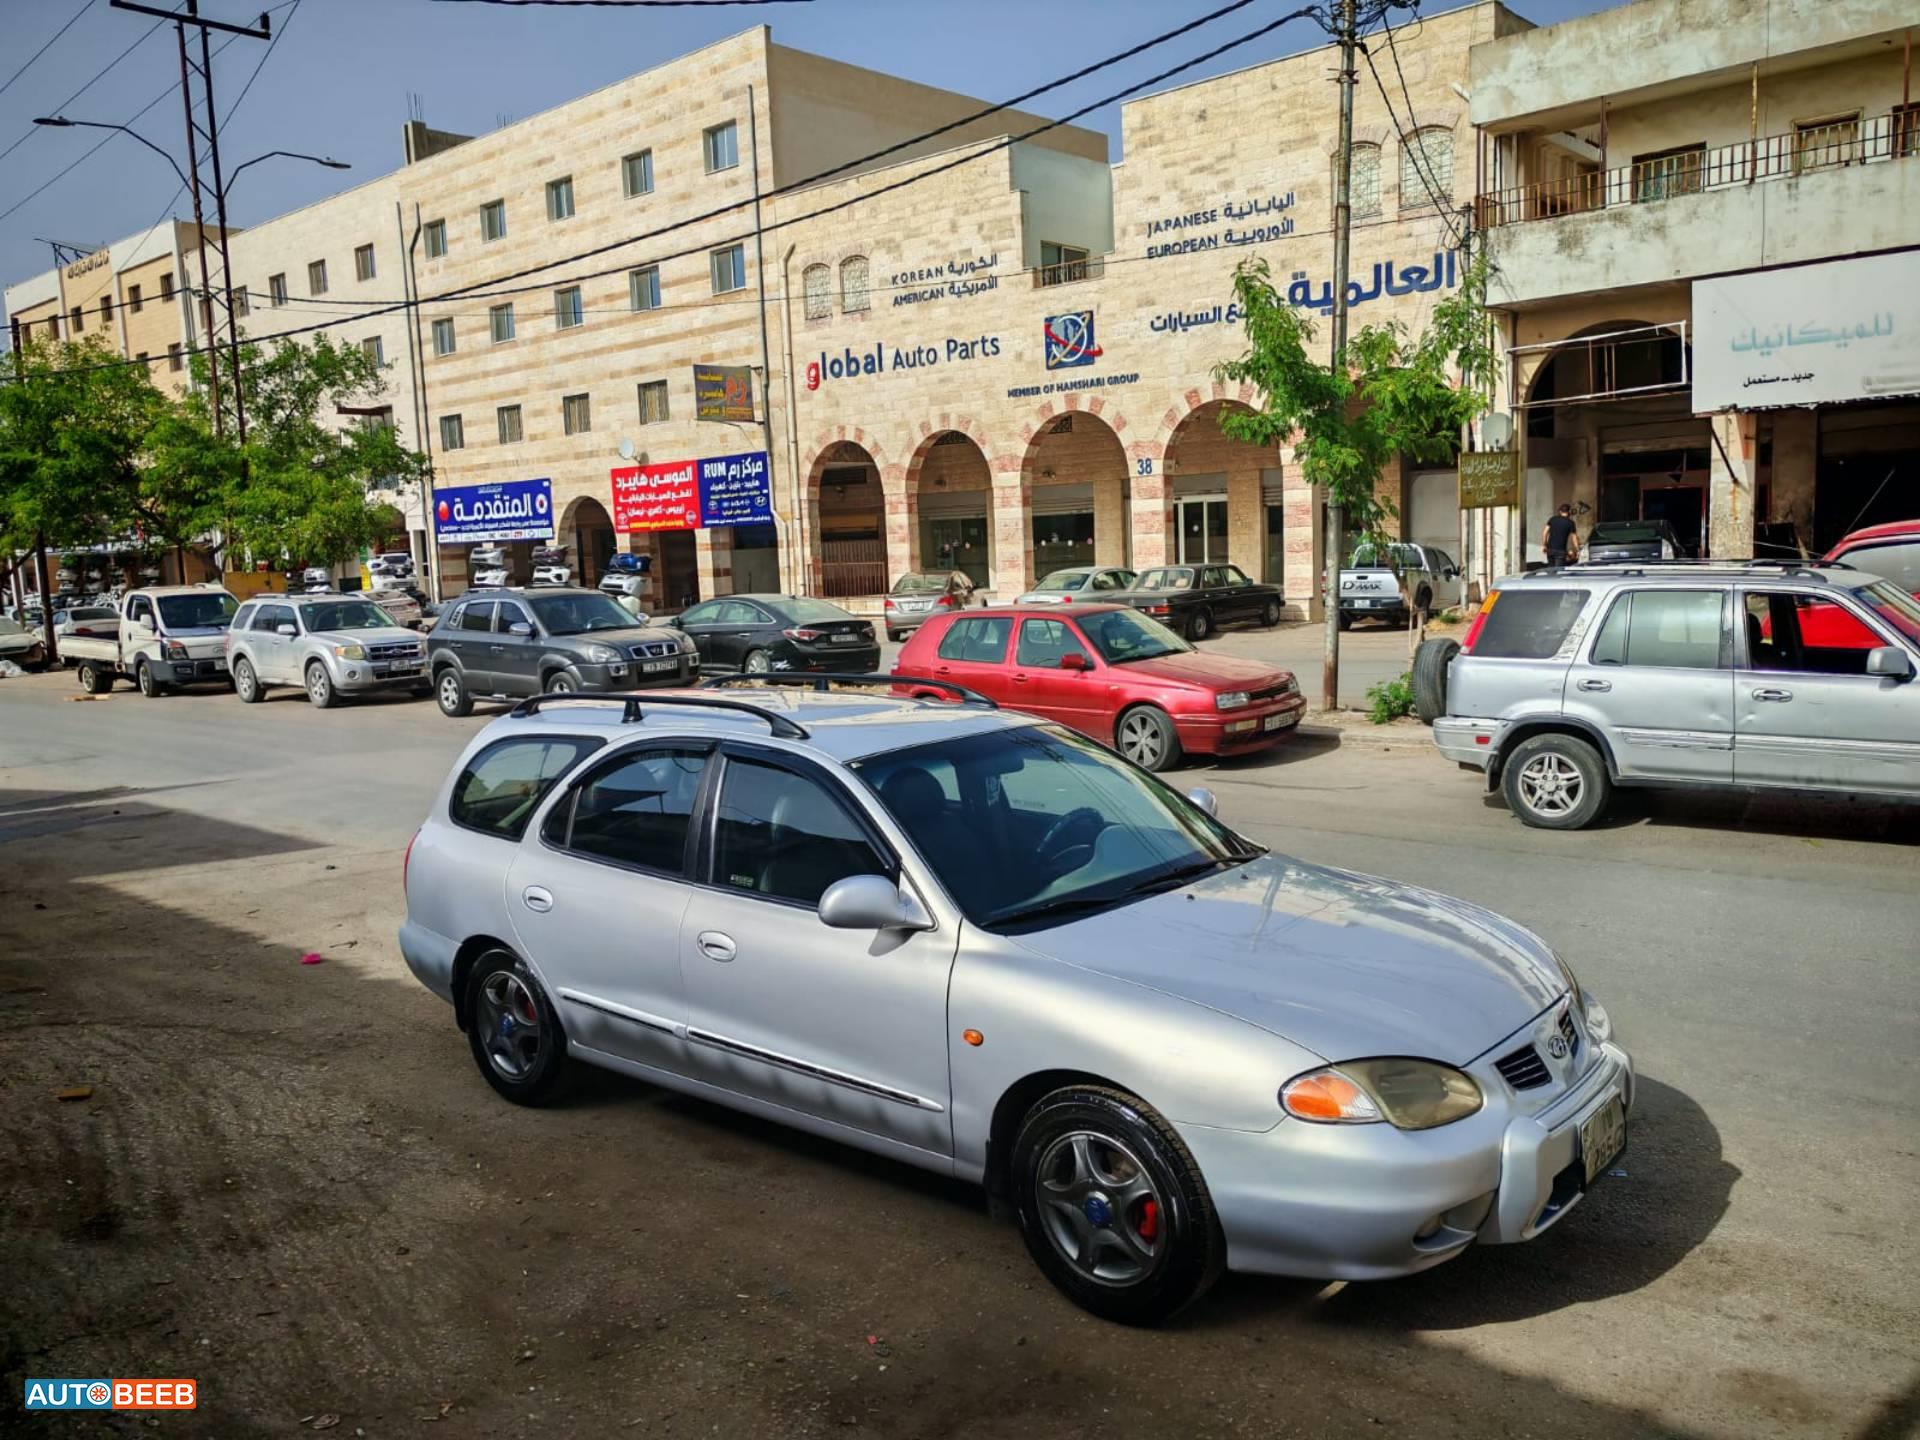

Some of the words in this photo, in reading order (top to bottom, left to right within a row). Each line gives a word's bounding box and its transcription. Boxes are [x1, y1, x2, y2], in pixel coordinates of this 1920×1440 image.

[1224, 192, 1294, 220] اليابانية
[1147, 209, 1217, 238] JAPANESE
[1147, 234, 1218, 258] EUROPEAN
[948, 252, 997, 276] الكورية
[891, 266, 943, 286] KOREAN
[1288, 249, 1455, 316] العالمية
[892, 287, 944, 307] AMERICAN
[1150, 305, 1222, 333] السيارات
[806, 342, 884, 391] global
[892, 345, 938, 371] Auto
[946, 335, 1001, 362] Parts
[1007, 386, 1041, 398] MEMBER
[1043, 384, 1055, 394] OF
[1056, 377, 1105, 392] HAMSHARI
[1107, 373, 1140, 386] GROUP
[1743, 373, 1780, 388] مستعمل
[1791, 371, 1815, 384] جديد
[704, 462, 726, 478] RUM
[728, 463, 740, 482] رم
[742, 456, 763, 478] مركز
[1137, 457, 1153, 475] 38
[615, 472, 649, 491] هايبرد
[453, 492, 533, 522] المتقدمة
